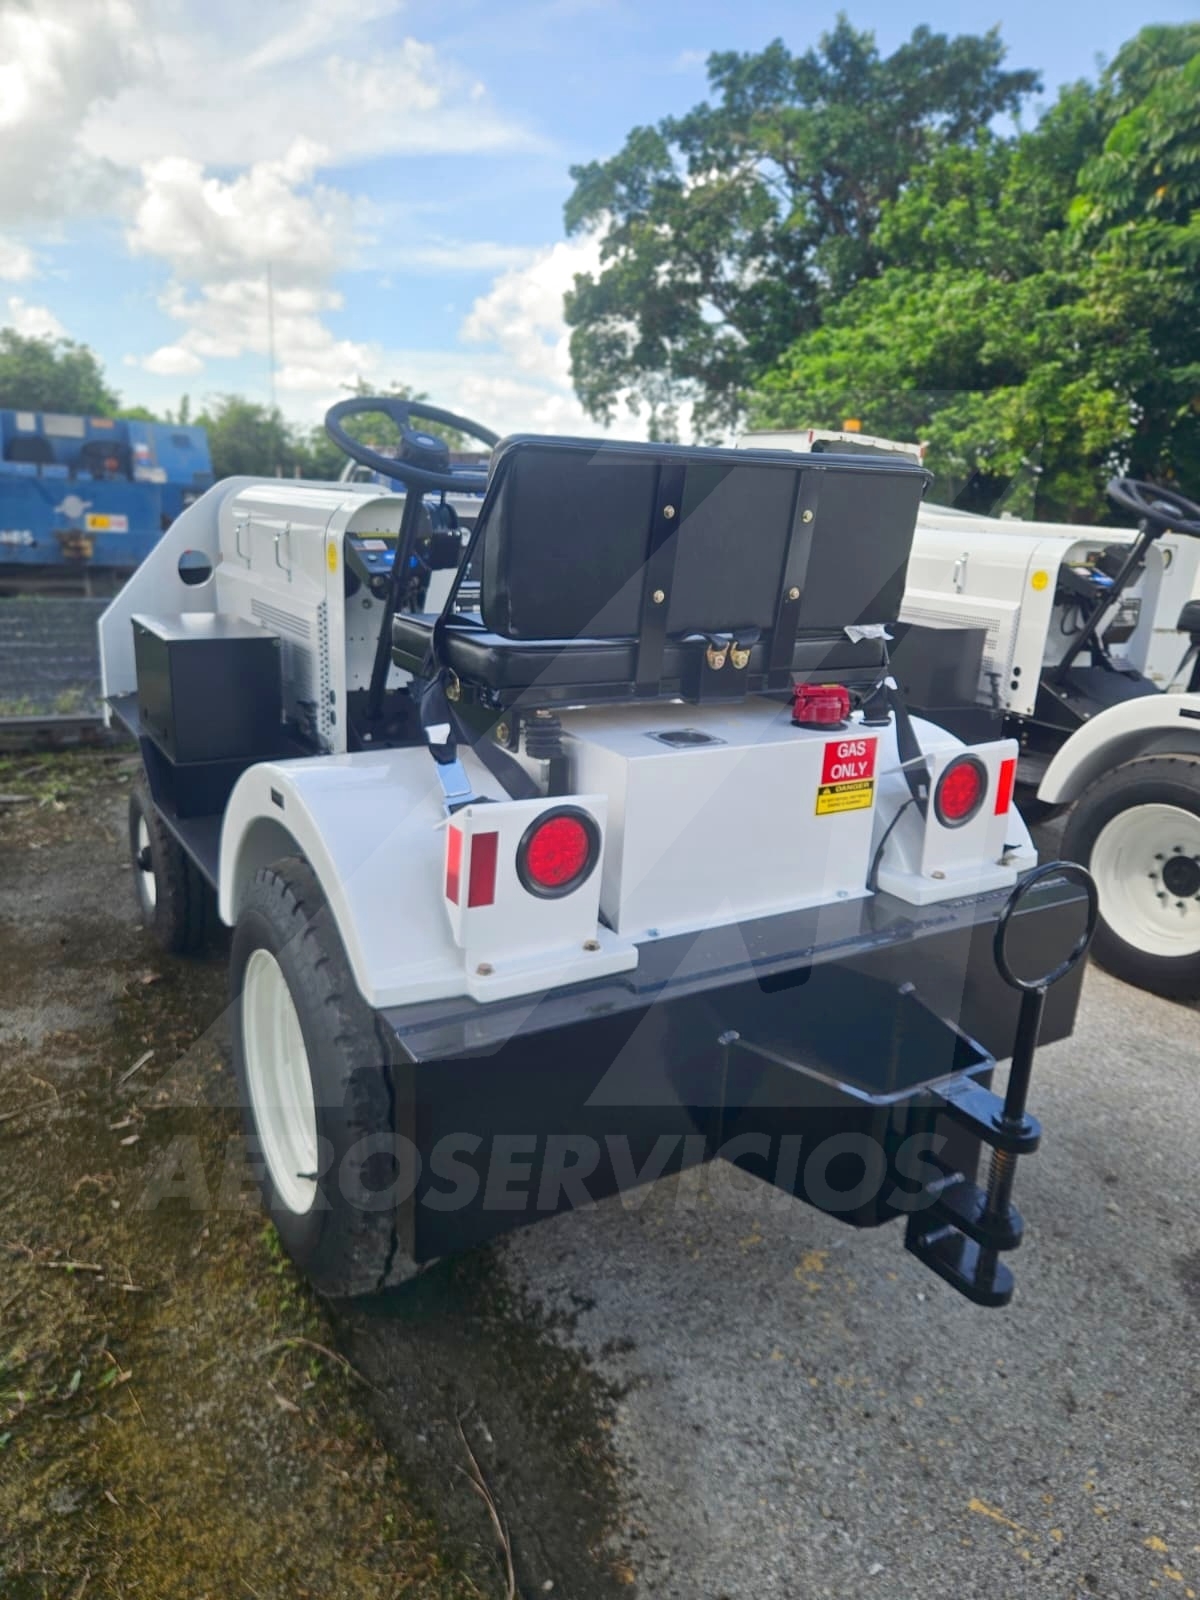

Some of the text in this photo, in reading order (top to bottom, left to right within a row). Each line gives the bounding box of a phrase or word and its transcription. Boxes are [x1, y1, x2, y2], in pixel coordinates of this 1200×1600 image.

[838, 741, 866, 758] GAS
[831, 761, 867, 779] ONLY
[835, 781, 870, 792] DANGER
